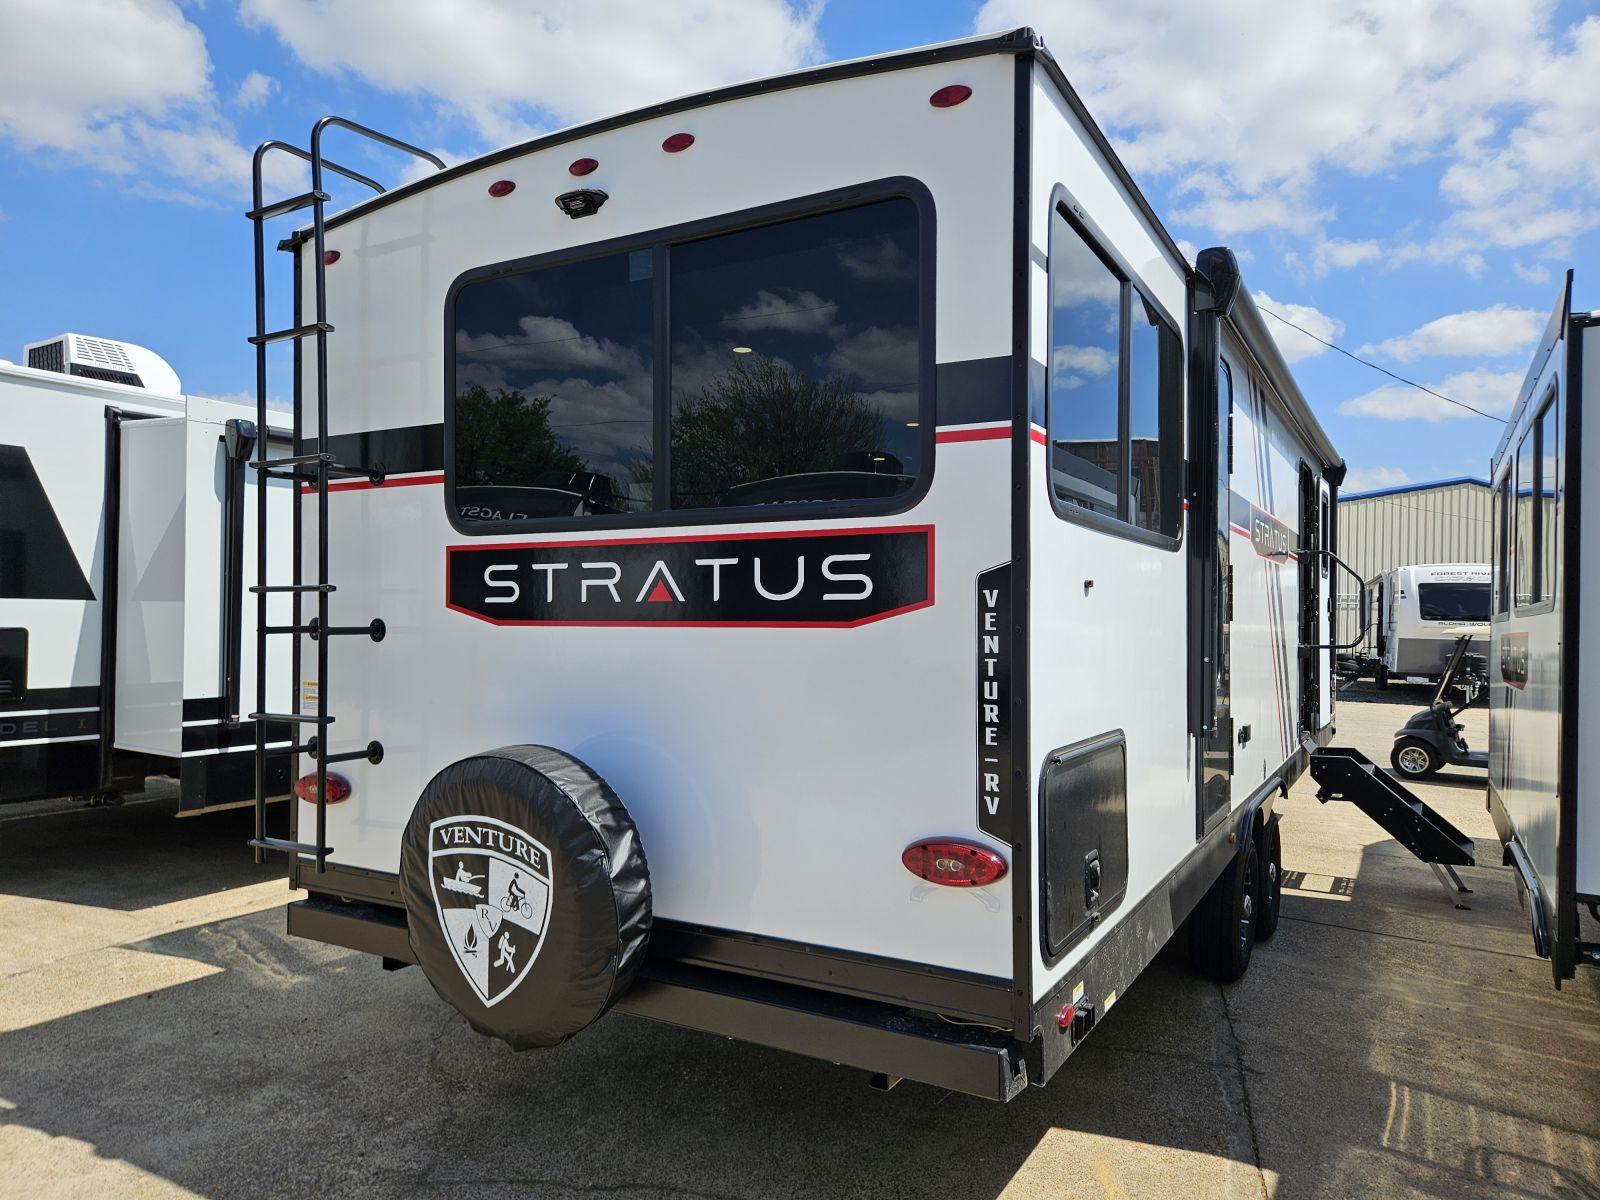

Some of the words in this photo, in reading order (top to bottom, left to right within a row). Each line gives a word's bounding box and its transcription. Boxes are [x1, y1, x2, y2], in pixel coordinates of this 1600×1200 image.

[1255, 519, 1287, 553] STRATUS
[484, 553, 873, 603] STRATUS
[440, 826, 541, 869] VENTURE
